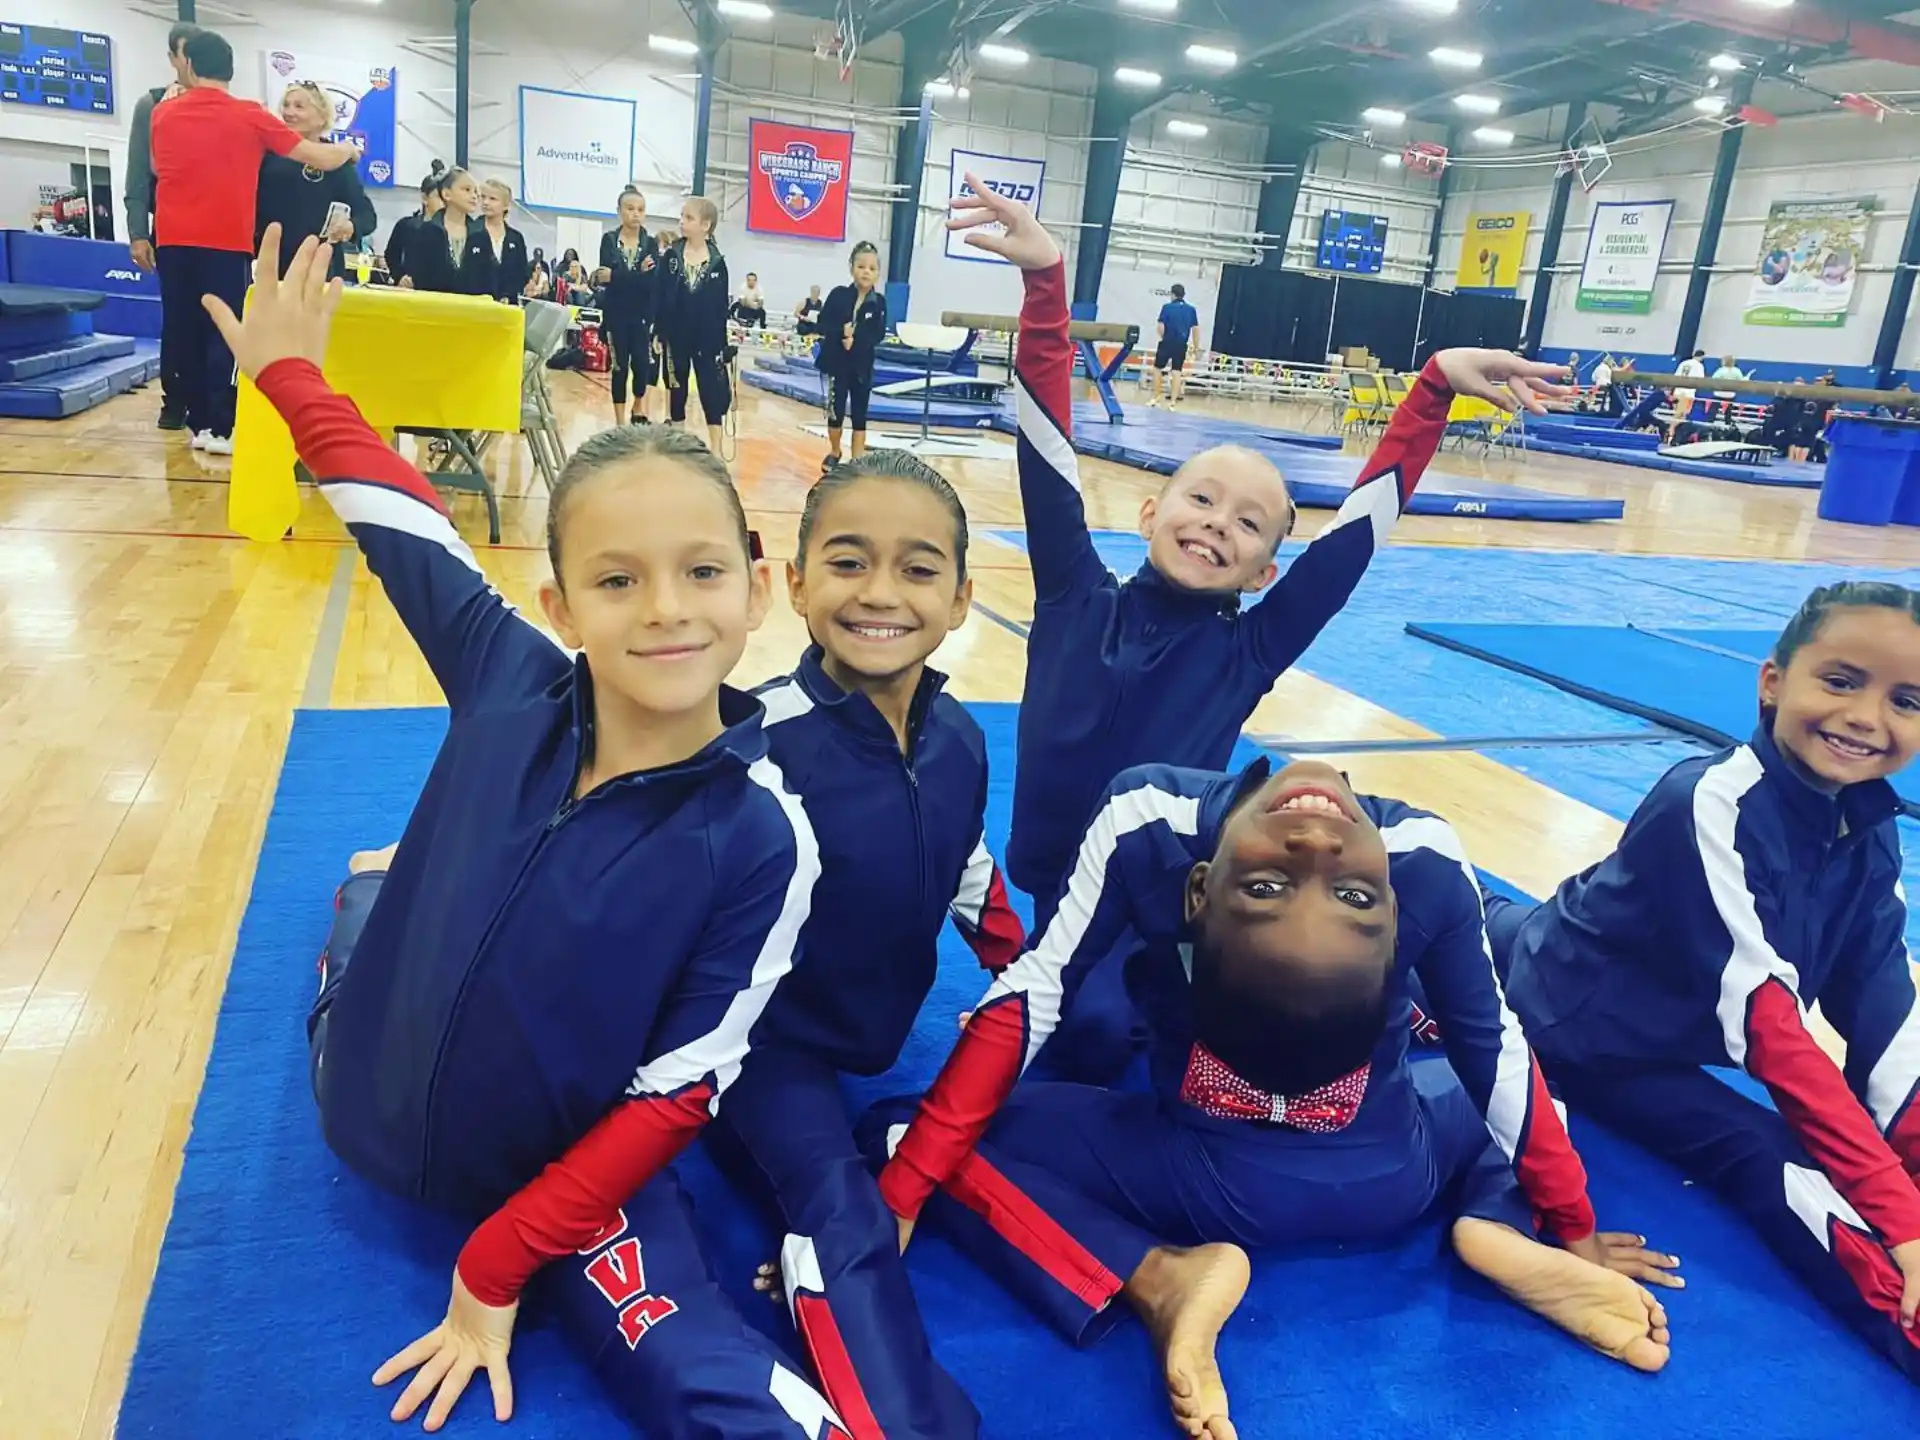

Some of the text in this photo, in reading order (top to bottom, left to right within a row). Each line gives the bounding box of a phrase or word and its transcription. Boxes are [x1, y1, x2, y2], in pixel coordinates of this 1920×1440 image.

[536, 145, 619, 165] AdventHealth
[761, 153, 810, 170] WIREGRASS
[1477, 217, 1514, 230] GEICO
[1621, 212, 1641, 226] PCG
